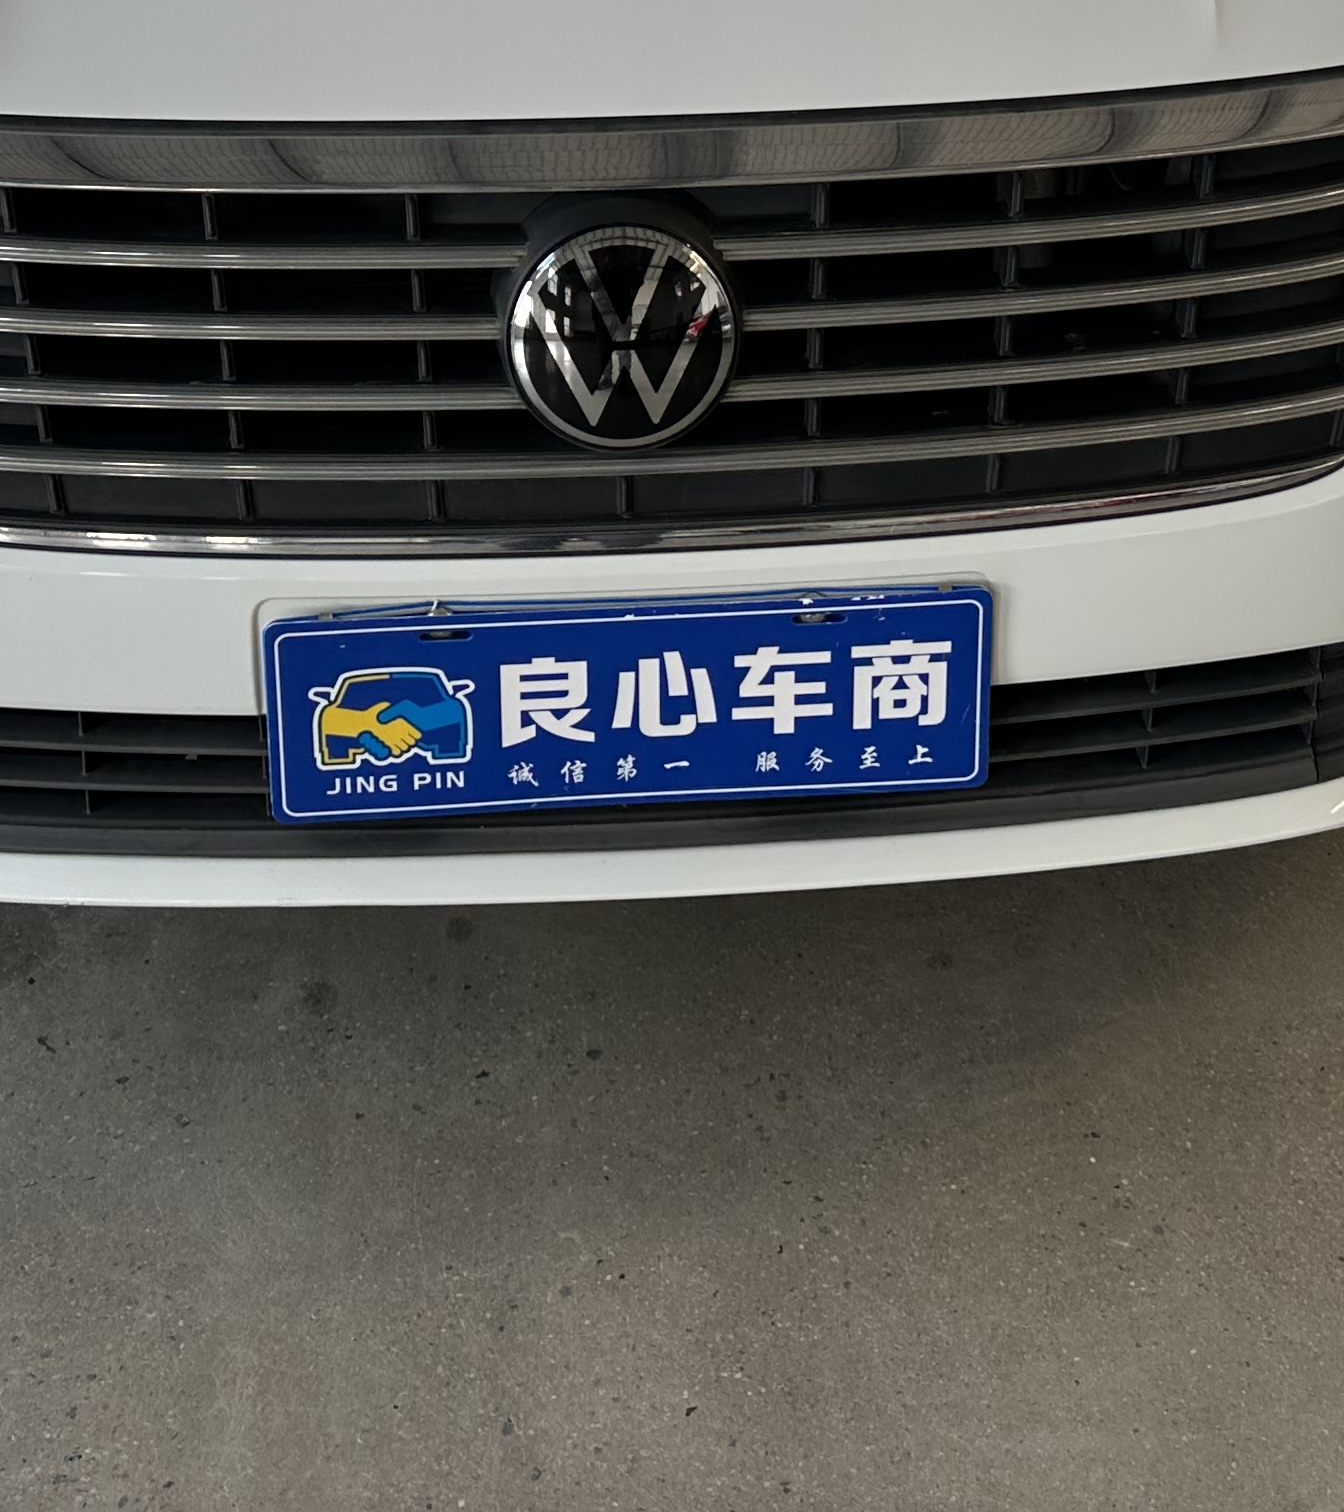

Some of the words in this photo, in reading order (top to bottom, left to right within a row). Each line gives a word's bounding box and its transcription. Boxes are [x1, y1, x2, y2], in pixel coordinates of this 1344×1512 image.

[499, 638, 953, 748] 良心车商
[326, 774, 399, 795] JING
[413, 770, 466, 790] PIN
[506, 758, 692, 788] 诚信第一
[754, 743, 935, 774] 服务至上
